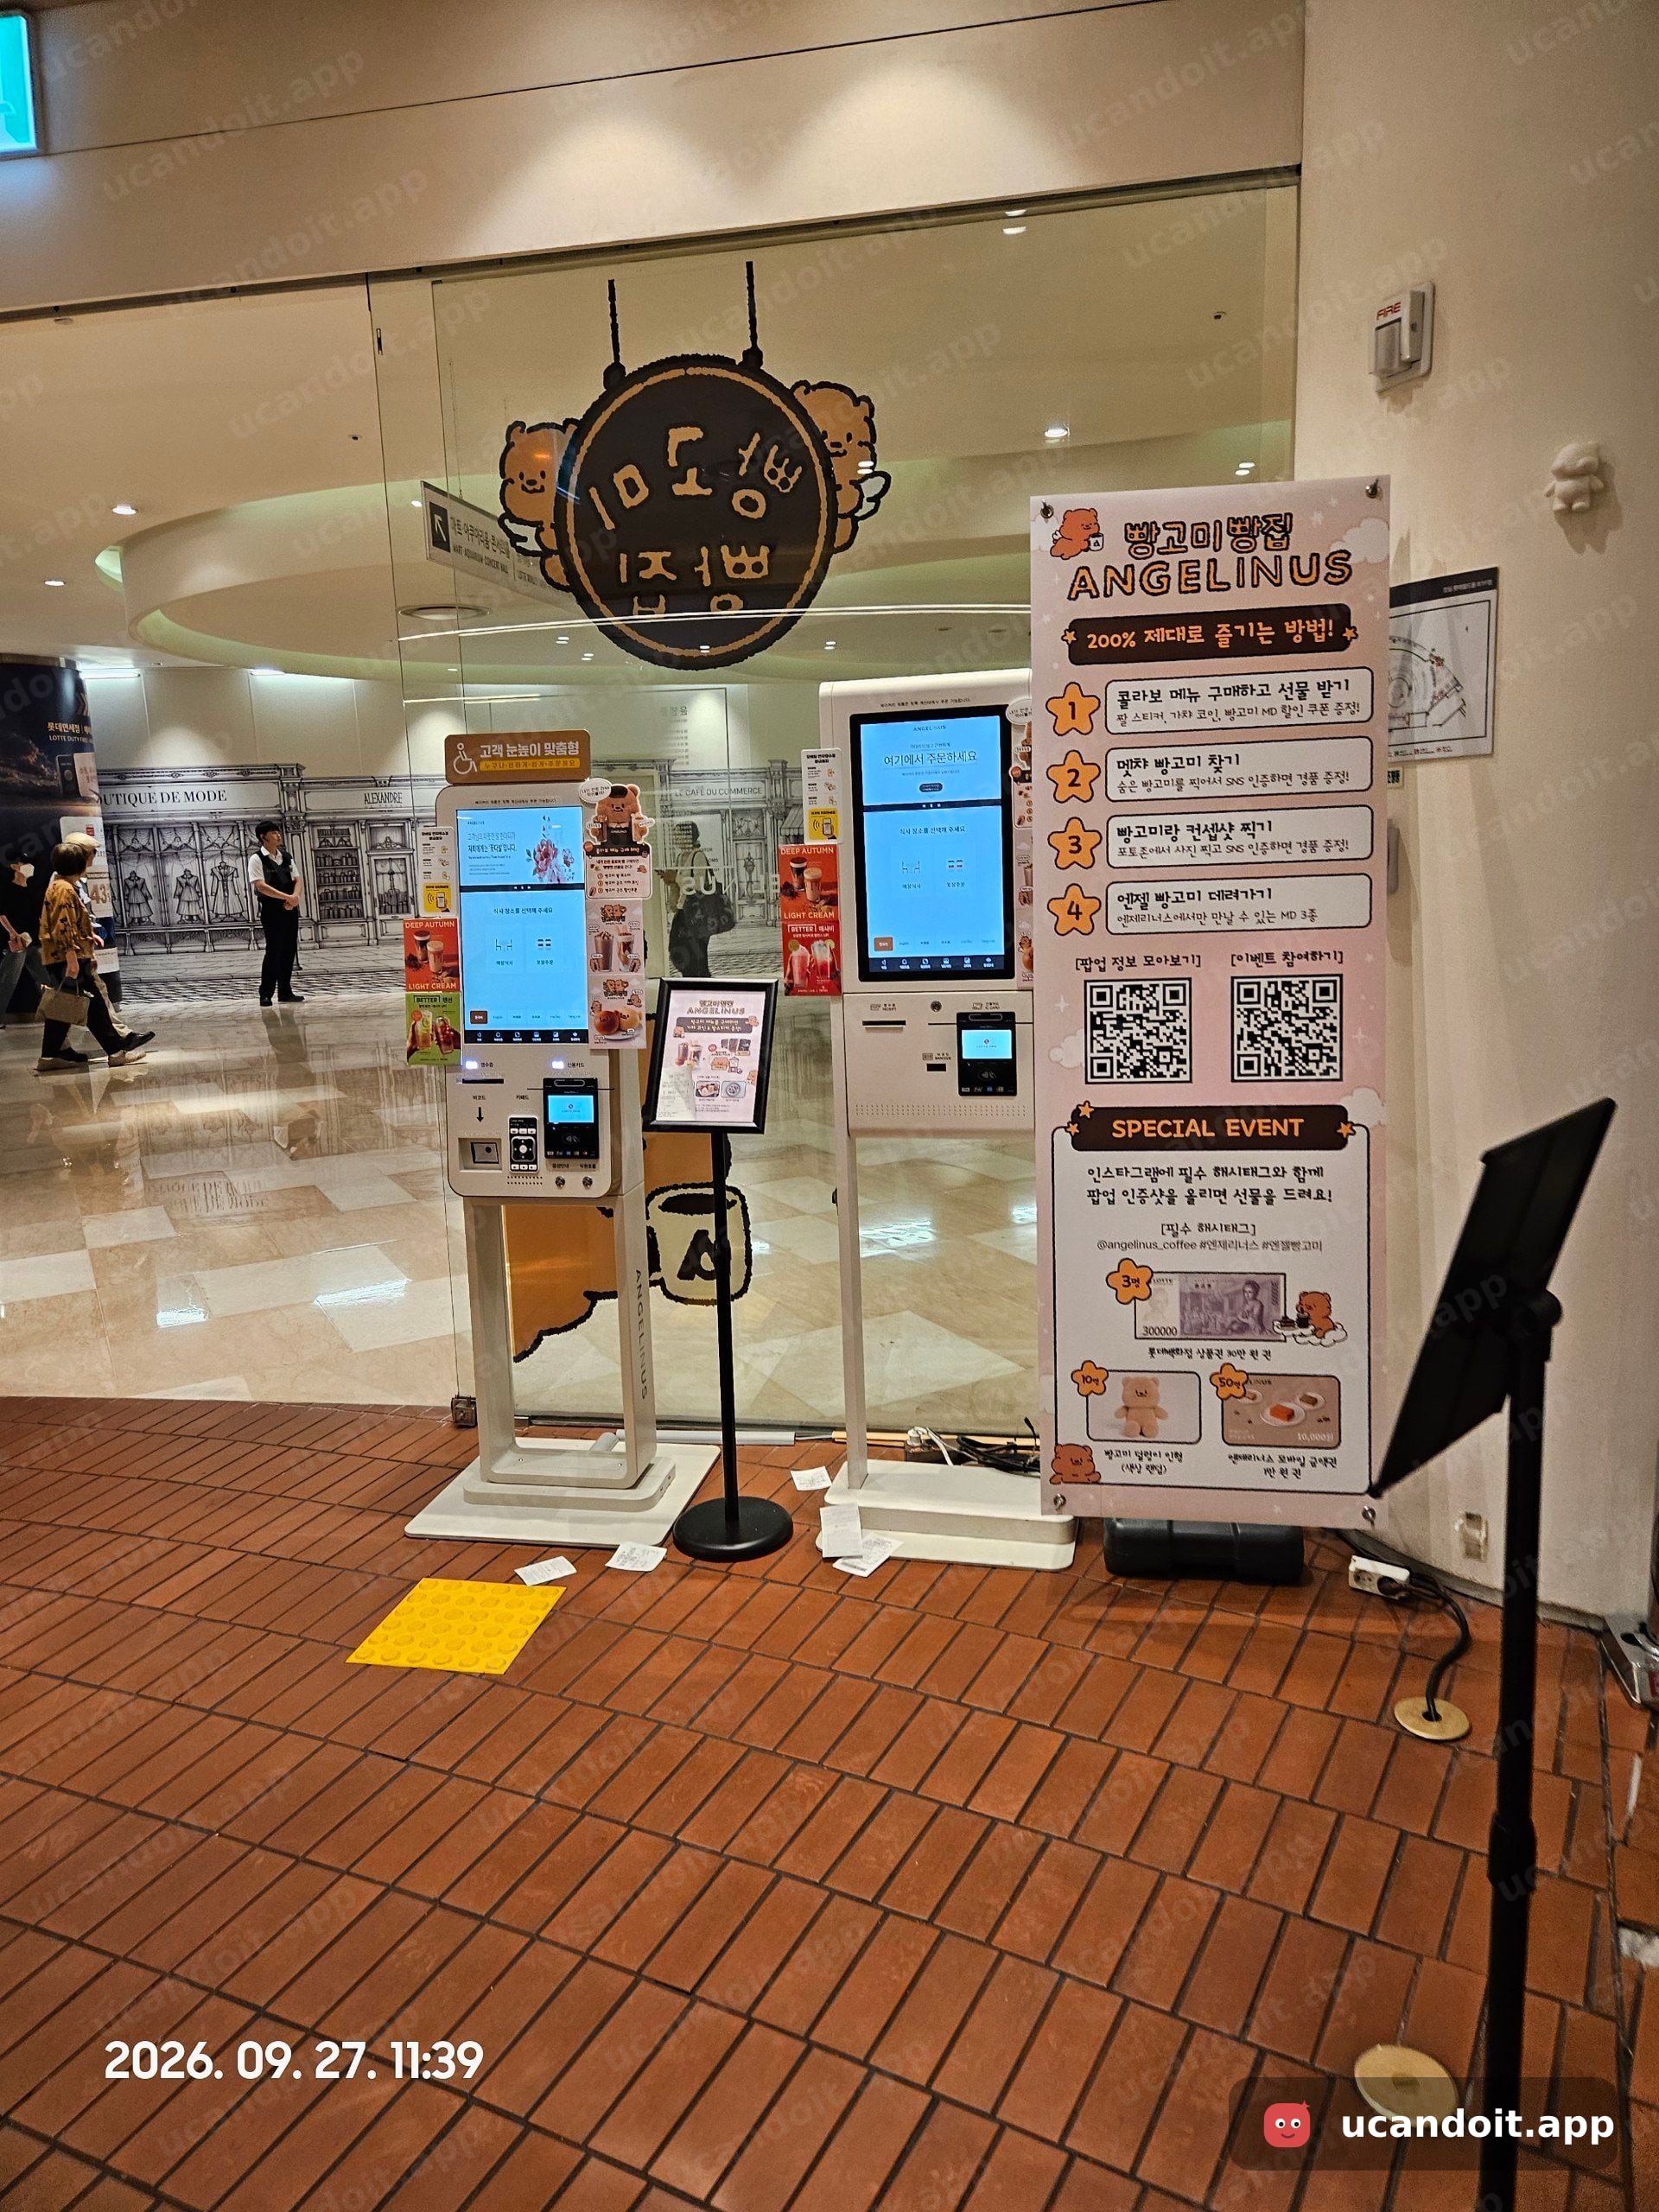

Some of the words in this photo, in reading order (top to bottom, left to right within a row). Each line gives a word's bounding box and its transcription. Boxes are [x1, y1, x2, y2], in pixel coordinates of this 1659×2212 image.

[1376, 301, 1402, 321] FIRE
[485, 556, 499, 569] CONCERT
[1067, 550, 1352, 601] ANGELINUS
[1087, 632, 1136, 650] 200%
[1144, 625, 1205, 645] 제대로
[1214, 622, 1275, 649] 즐기는
[1285, 618, 1334, 643] 방법!
[1117, 690, 1162, 709] 콜라보
[1170, 688, 1200, 702] 메뉴
[1208, 683, 1271, 701] 구매하고
[1279, 681, 1310, 701] 선물
[1317, 678, 1350, 699] 받기
[1068, 702, 1077, 721] 1
[1132, 711, 1166, 724] 스티커,
[1169, 709, 1192, 721] 가챠
[1196, 709, 1221, 722] 코인,
[1224, 707, 1258, 721] 빵고미
[1262, 708, 1278, 716] MD
[1281, 704, 1304, 718] 할인
[1307, 703, 1329, 716] 쿠폰
[1334, 702, 1360, 715] 증정!
[480, 744, 503, 758] 고객
[506, 743, 541, 758] 눈높이
[544, 741, 580, 756] 맞춤형
[884, 753, 924, 766] 여기에서
[926, 750, 977, 765] 주문하세요
[1154, 755, 1201, 776] 빵고미
[1208, 753, 1241, 773] 찾기
[1067, 768, 1081, 787] 2
[1116, 780, 1138, 794] 숨은
[1141, 779, 1185, 792] 빵고미를
[1189, 777, 1222, 791] 찍어서
[1225, 777, 1244, 786] SNS
[1248, 774, 1293, 789] 인증하면
[1297, 772, 1319, 786] 경품
[1324, 771, 1350, 785] 증정!
[97, 791, 156, 807] UTIQUE
[161, 791, 180, 804] DE
[184, 790, 227, 803] MODE
[364, 792, 403, 804] ALEXANDRE
[1116, 824, 1180, 843] 빵고미랑
[1186, 822, 1235, 842] 컨셉샷
[1240, 820, 1273, 839] 찍기
[1069, 836, 1082, 855] 3
[1117, 846, 1171, 860] 포토존에서
[1175, 844, 1197, 858] 사진
[1200, 843, 1223, 857] 찍고
[1225, 844, 1244, 854] SNS
[1248, 841, 1293, 855] 인증하면
[1297, 840, 1319, 855] 경품
[1323, 839, 1349, 853] 증정!
[1117, 892, 1150, 911] 엔젤
[1155, 890, 1201, 909] 빵고미
[1208, 887, 1273, 902] 데려가기
[1067, 900, 1083, 920] 4
[1116, 912, 1207, 928] 엔제리너스에서만
[1211, 911, 1235, 925] 만날
[1238, 910, 1249, 922] 수
[1254, 909, 1276, 925] 있는
[1281, 911, 1297, 920] MD
[1300, 908, 1319, 921] 3종
[1075, 957, 1107, 972] [팝업
[1111, 956, 1138, 972] 정보
[1142, 954, 1201, 969] 모아보기]
[1230, 950, 1277, 967] [이벤트
[1281, 950, 1344, 966] 참여하기]
[1111, 1119, 1215, 1138] SPECIAL
[1225, 1118, 1305, 1137] EVENT
[1087, 1166, 1173, 1184] 인스타그램에
[1178, 1166, 1207, 1183] 필수
[1212, 1166, 1287, 1179] 해시태그와
[1292, 1166, 1324, 1183] 함께
[1087, 1189, 1116, 1205] 팝업
[1122, 1189, 1178, 1205] 인증샷을
[1185, 1189, 1227, 1205] 올리면
[1233, 1189, 1277, 1205] 선물을
[1283, 1188, 1332, 1202] 드려요!
[1161, 1223, 1192, 1237] [필수
[1198, 1223, 1255, 1236] 해시태그]
[1096, 1239, 1197, 1250] @angelinus_coffee
[1199, 1240, 1259, 1251] #엔제리너스
[1122, 1275, 1141, 1288] 3명
[635, 1269, 647, 1400] ANGELINUS
[1141, 1325, 1178, 1336] 300000
